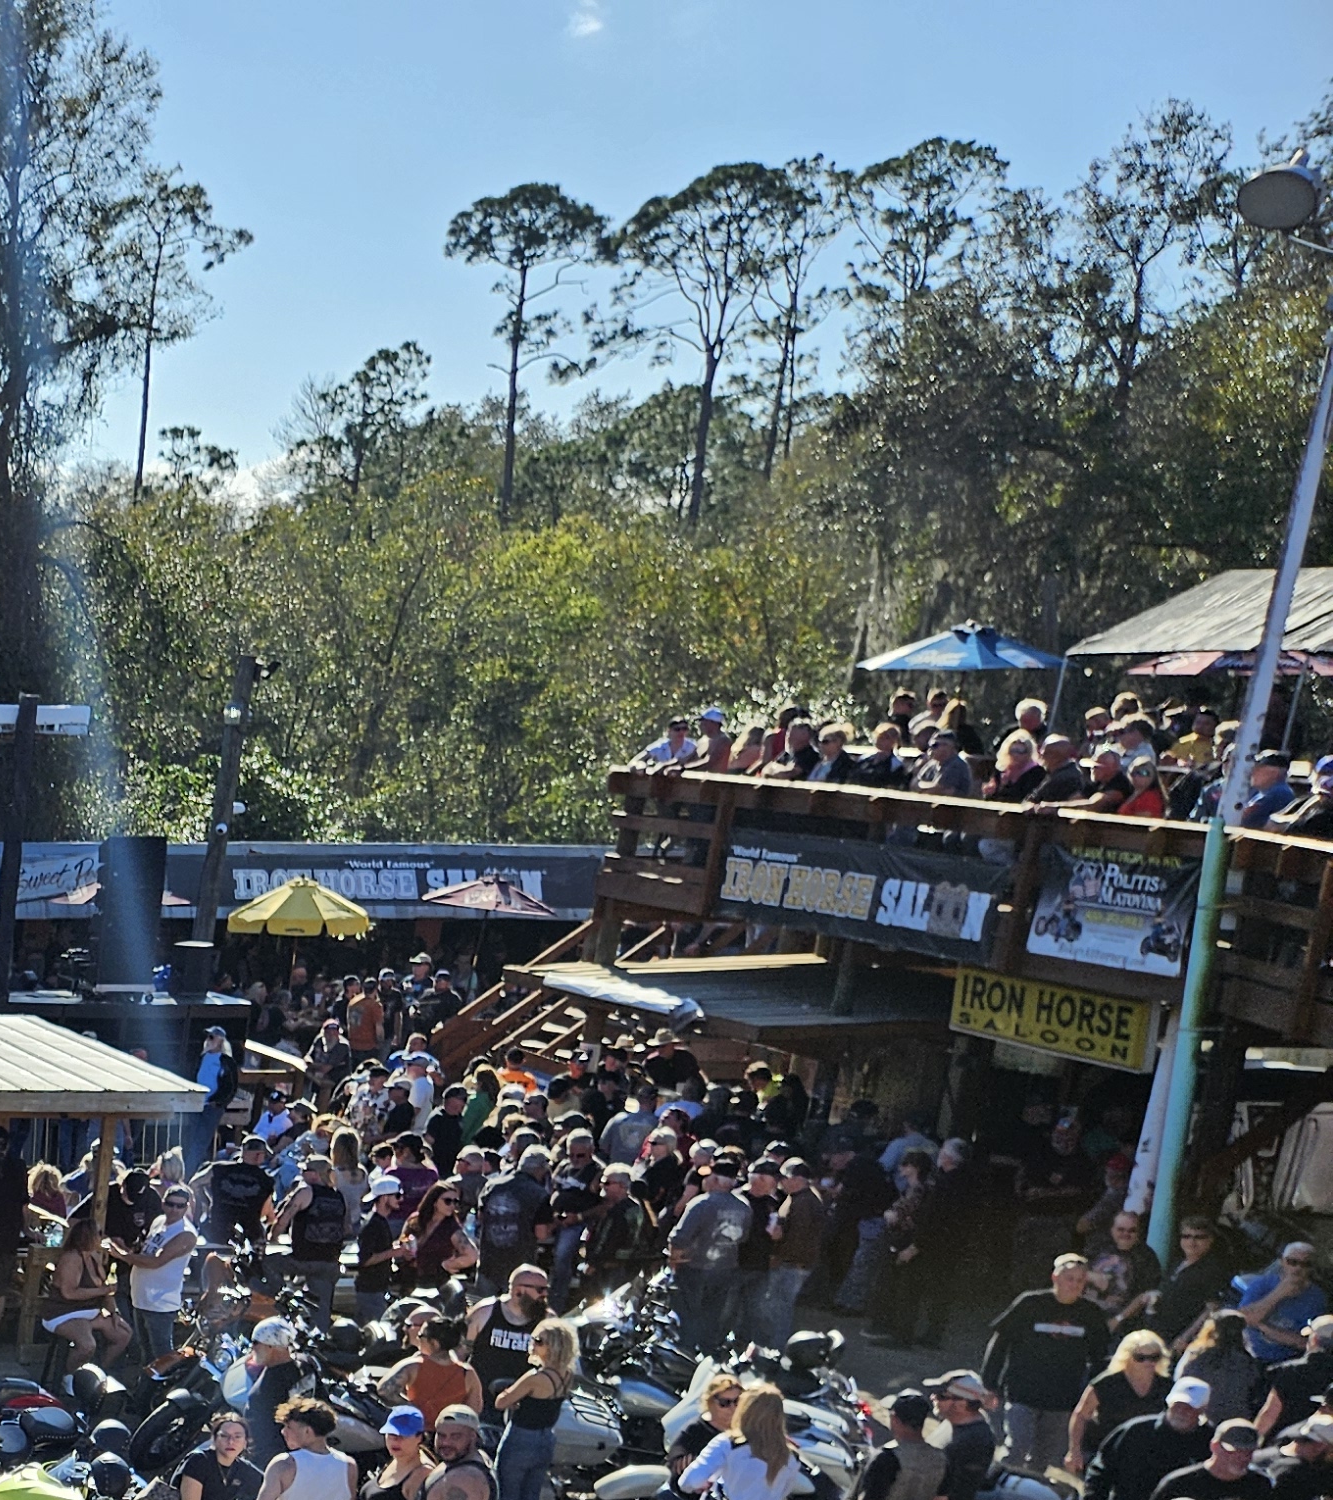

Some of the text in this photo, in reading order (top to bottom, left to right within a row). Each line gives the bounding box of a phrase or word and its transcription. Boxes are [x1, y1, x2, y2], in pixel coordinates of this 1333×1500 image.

[320, 868, 419, 899] HORSE
[721, 857, 788, 907] IRON
[783, 864, 877, 920] HORSE
[961, 974, 1144, 1042] IRON HORSE
[511, 1340, 534, 1352] CRE
